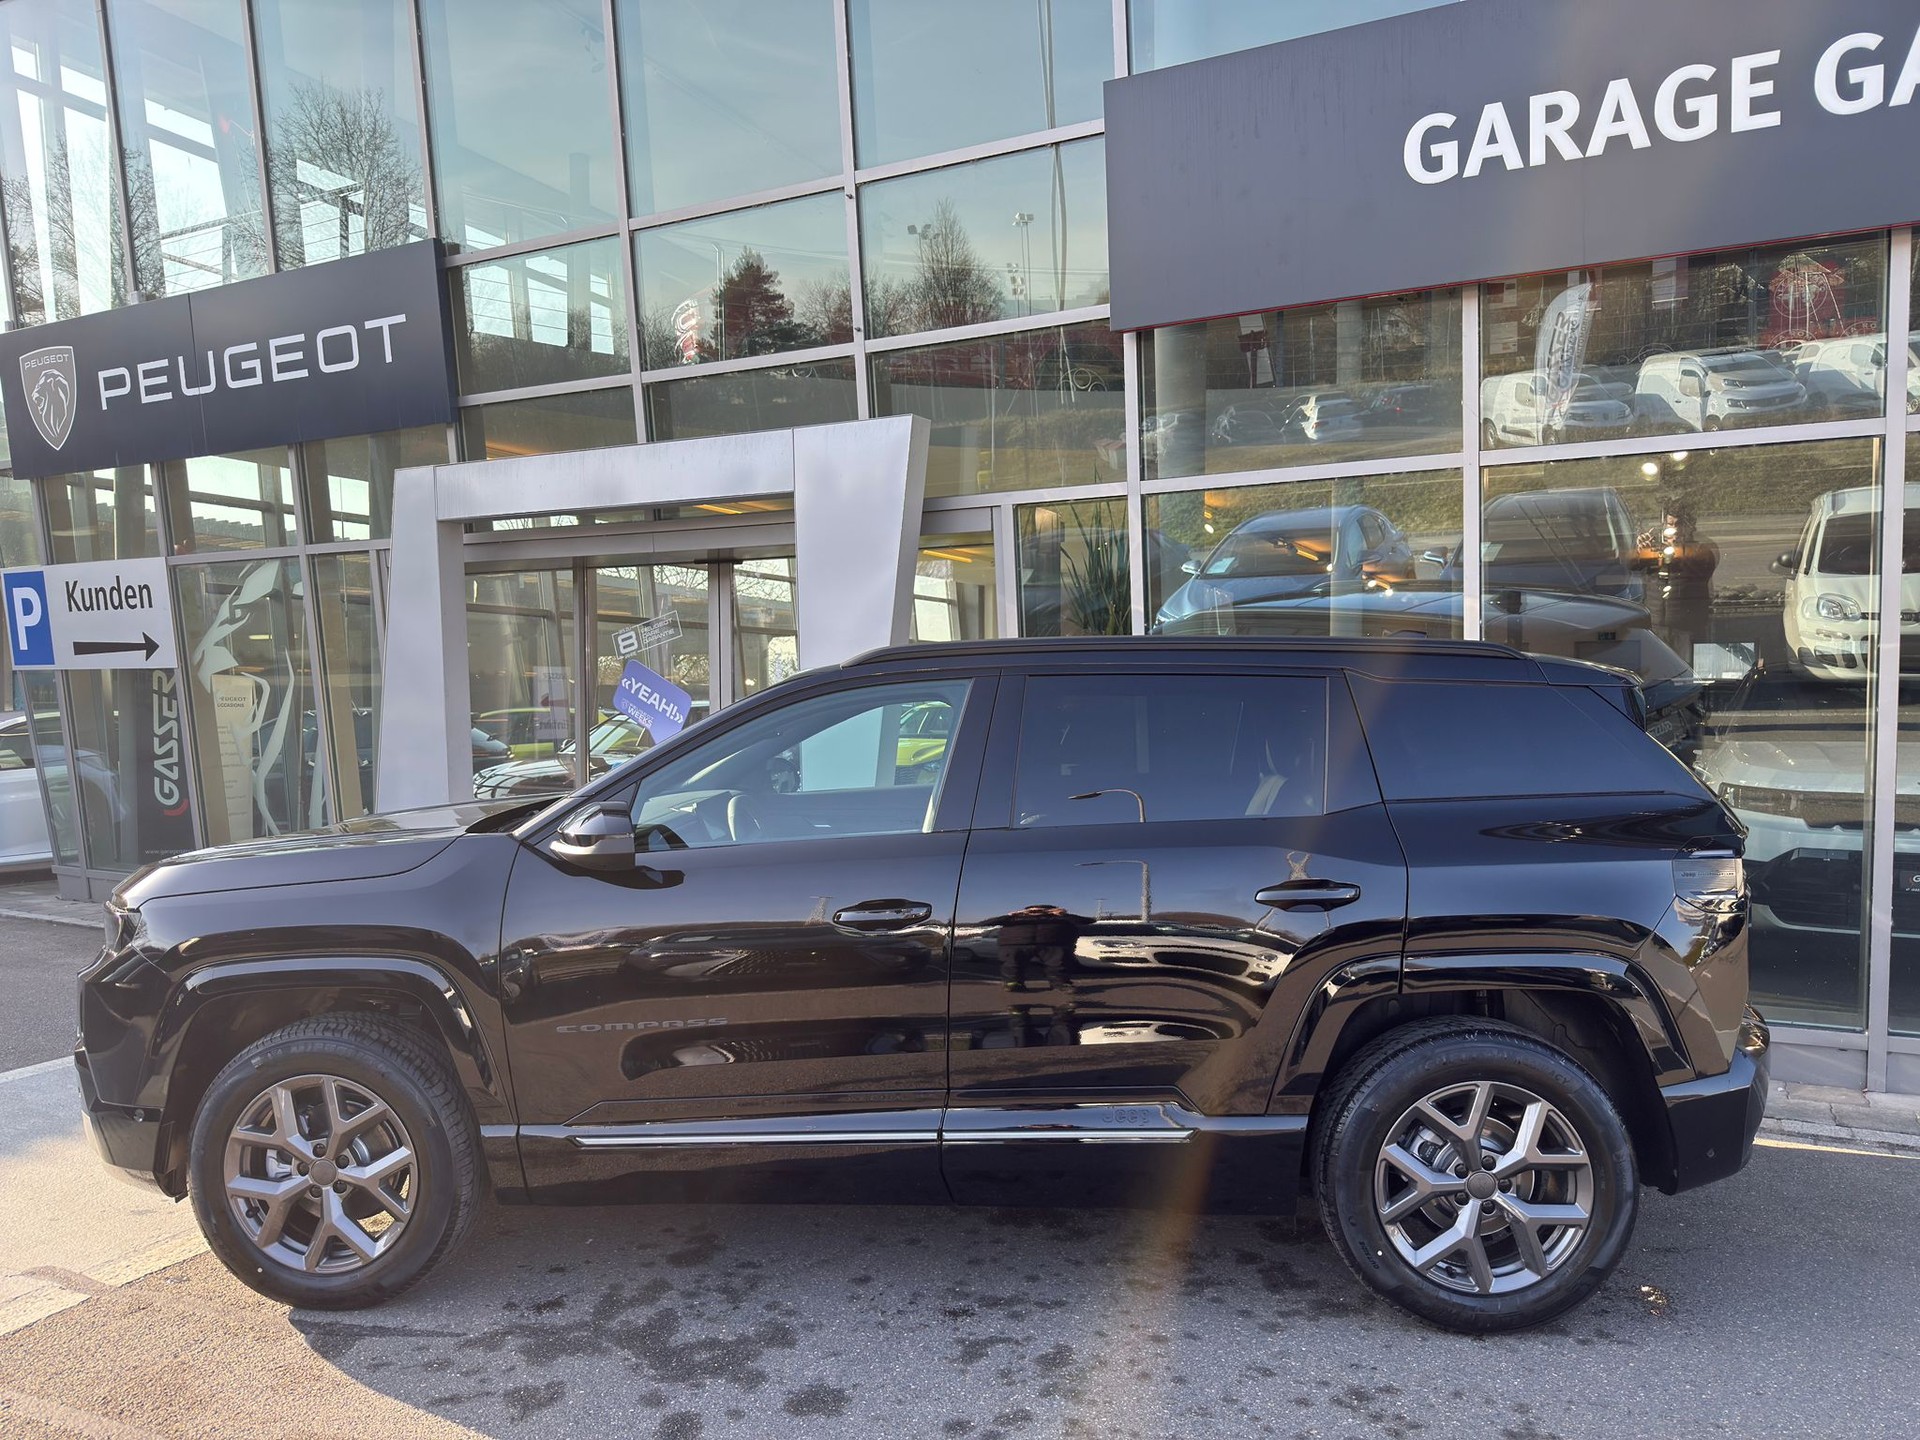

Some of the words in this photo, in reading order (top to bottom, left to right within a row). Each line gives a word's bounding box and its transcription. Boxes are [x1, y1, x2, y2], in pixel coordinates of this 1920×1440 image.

[1403, 49, 1781, 184] GARAGE
[24, 354, 69, 370] PEUGEOT
[98, 314, 406, 410] PEUGEOT
[12, 587, 42, 650] P
[65, 575, 153, 612] Kunden
[617, 631, 638, 654] 8
[152, 670, 179, 806] GASSER
